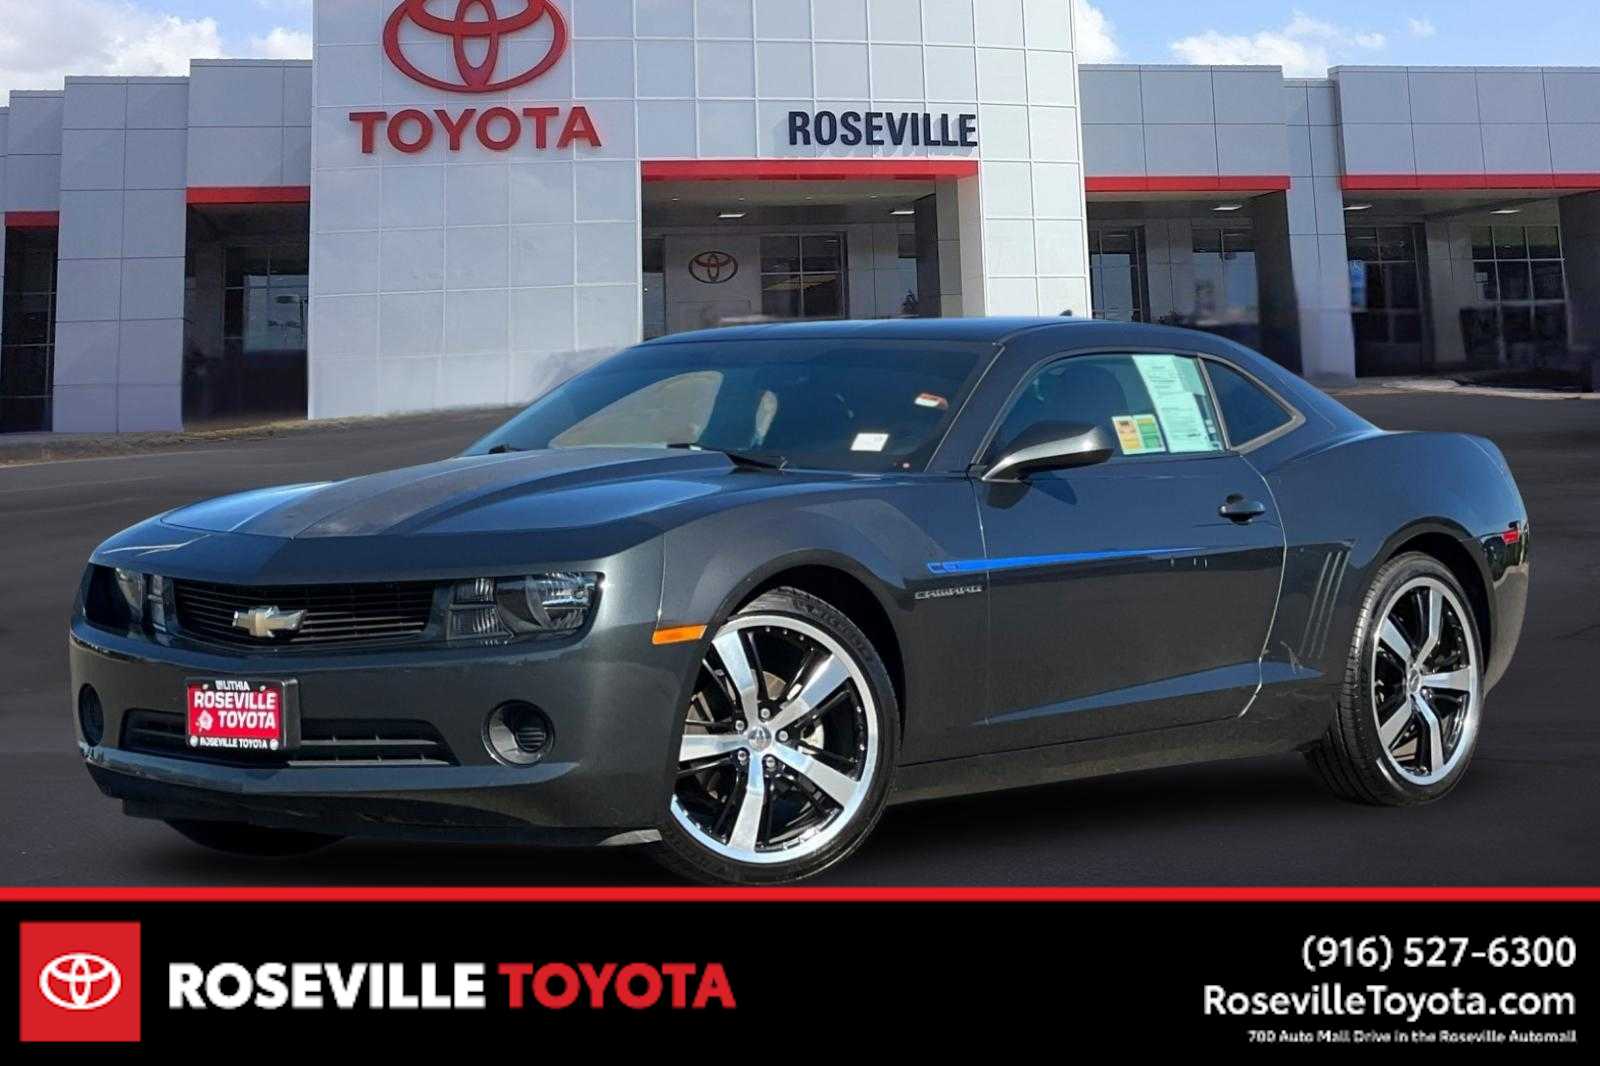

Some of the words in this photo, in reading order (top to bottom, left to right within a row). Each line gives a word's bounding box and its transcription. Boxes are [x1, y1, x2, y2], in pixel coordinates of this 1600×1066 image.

[349, 105, 602, 153] TOYOTA
[788, 110, 978, 147] ROSEVILLE
[194, 691, 277, 710] ROSEVILLE
[218, 710, 276, 729] TOYOTA
[200, 737, 238, 748] ROSEVILLE
[239, 739, 268, 749] TOYOTA
